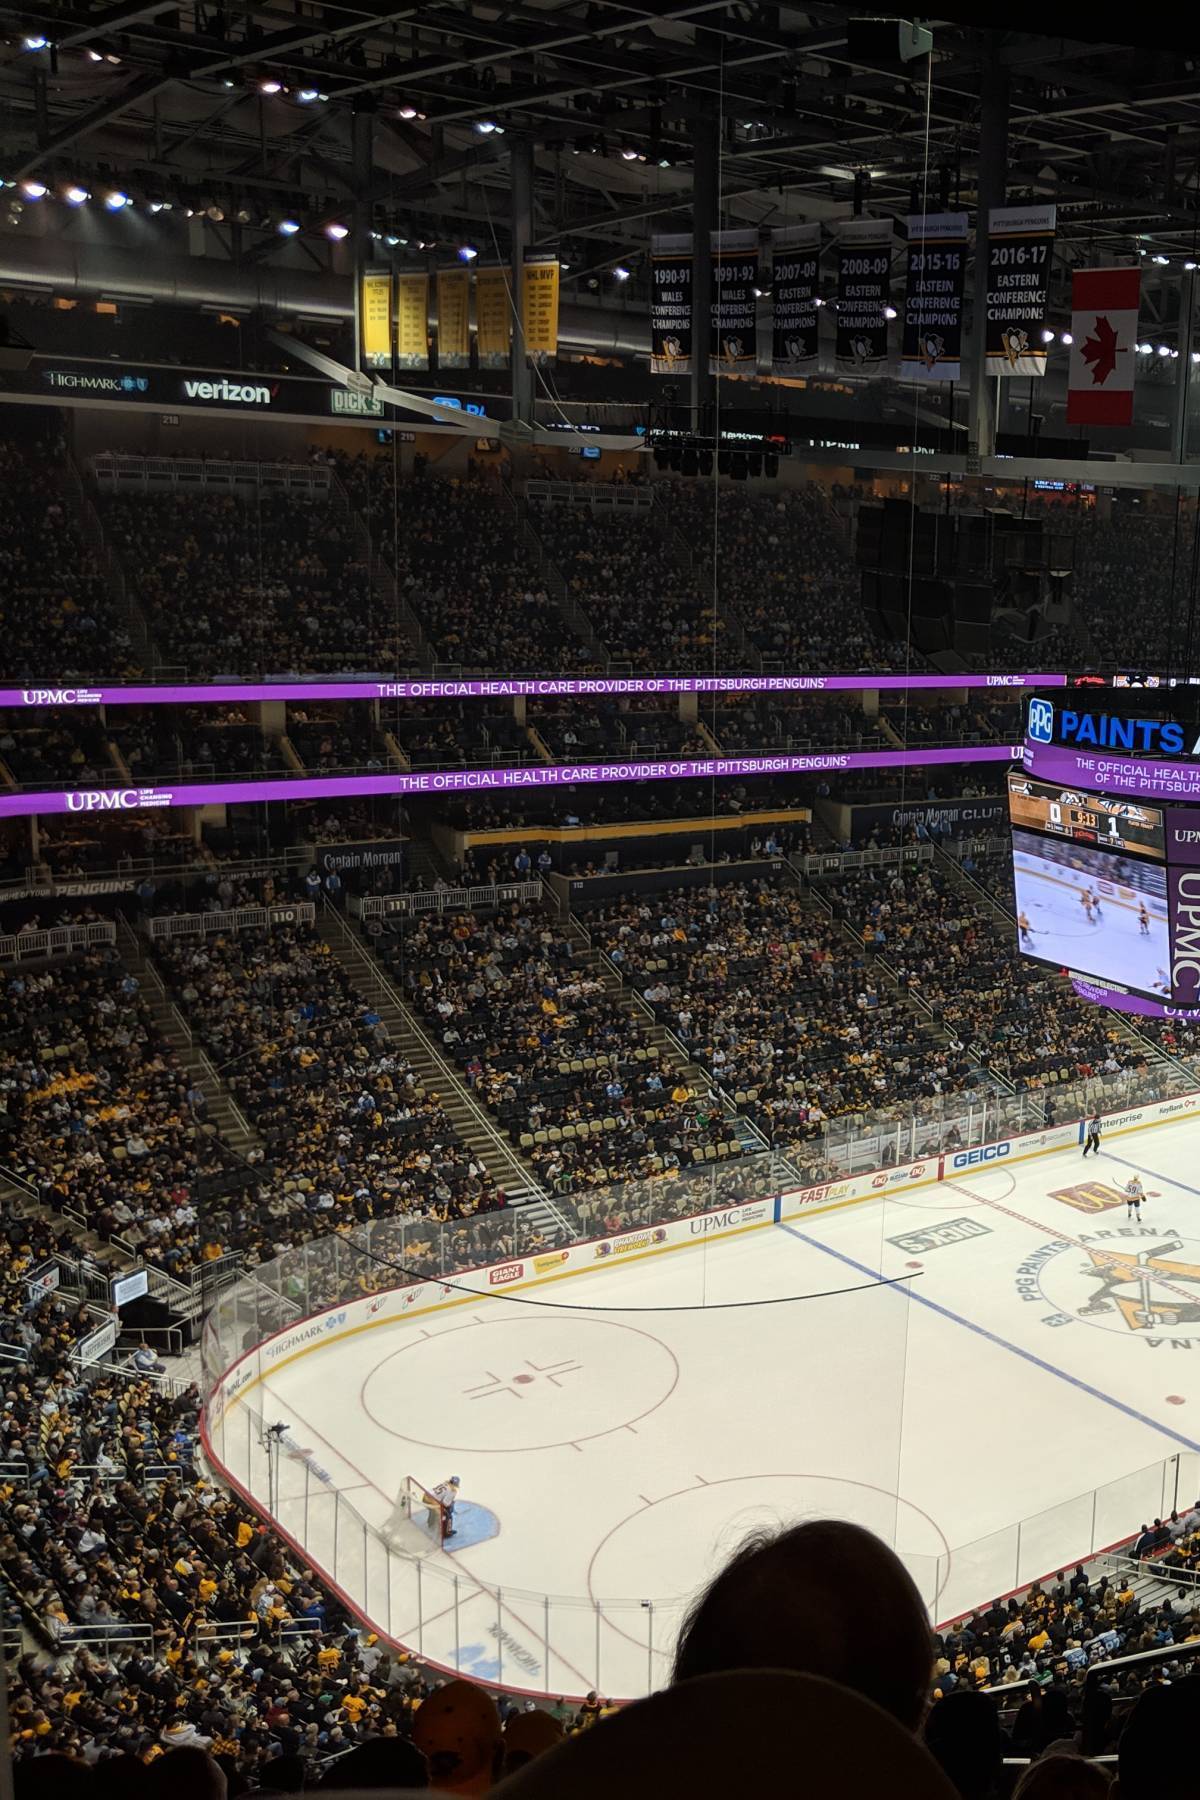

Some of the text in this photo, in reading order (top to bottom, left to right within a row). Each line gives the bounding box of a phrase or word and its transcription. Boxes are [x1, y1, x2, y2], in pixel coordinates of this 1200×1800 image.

[993, 217, 1049, 228] PITTSBURGH PENGUINS
[911, 254, 960, 270] 2015-16
[991, 246, 1047, 265] 2016-17
[714, 266, 754, 282] 1991-92
[775, 261, 816, 281] 2007-08
[841, 258, 888, 274] 2008-09
[654, 268, 690, 284] 1990-91
[997, 274, 1039, 287] EASTERN
[779, 286, 812, 299] EASTERN
[845, 285, 881, 297] EASTERN
[916, 280, 954, 292] EASTERN
[662, 291, 683, 302] WALES
[722, 290, 745, 300] WALES
[987, 291, 1046, 304] CONFERENCE
[652, 305, 691, 315] CONFERENCE
[988, 308, 1043, 320] CHAMPIONS
[653, 319, 690, 329] CHAMPIONS
[712, 318, 753, 329] CHAMPIONS
[51, 372, 119, 390] HIGHMARK
[184, 380, 271, 403] verizon
[377, 684, 406, 697] THE
[410, 683, 476, 696] OFFICIAL
[481, 682, 535, 695] HEALTH
[538, 681, 575, 693] CARE
[578, 680, 644, 693] PROVIDER
[647, 679, 664, 692] OF
[668, 679, 691, 691] THE
[695, 678, 767, 690] PITTSBURGH
[986, 676, 1012, 686] UPMC
[23, 690, 76, 704] UPMC
[1031, 704, 1051, 736] PPG
[1061, 710, 1185, 753] PAINTS
[400, 777, 429, 790] THE
[433, 773, 499, 789] OFFICIAL
[503, 770, 558, 784] HEALTH
[561, 768, 598, 780] CARE
[601, 764, 667, 779] PROVIDER
[670, 763, 688, 775] OF
[690, 761, 714, 774] THE
[717, 758, 789, 772] PITTSBURGH
[1076, 757, 1096, 770] THE
[1097, 761, 1151, 778] OFFICIAL
[1095, 772, 1111, 784] OF
[1113, 774, 1136, 788] THE
[67, 790, 138, 811] UPMC
[1050, 803, 1062, 823] 0
[1077, 812, 1096, 826] 9:13
[1108, 817, 1120, 838] 1
[324, 850, 401, 871] Captain Morgan
[825, 858, 839, 867] 113
[55, 880, 137, 897] PENGUINS
[502, 889, 518, 899] 111
[389, 901, 406, 910] 111
[272, 911, 294, 922] 110
[1159, 1102, 1184, 1115] KeyBank
[1100, 1112, 1143, 1129] nterprise
[953, 1143, 1010, 1168] GEICO
[874, 1176, 886, 1186] DQ
[912, 1167, 924, 1176] DQ
[690, 1211, 740, 1235] UPMC
[898, 1219, 982, 1254] DICK'S
[492, 1265, 520, 1276] GIANT
[1015, 1227, 1181, 1302] PPG PAINTS ARENA
[492, 1272, 520, 1283] EAGLE
[266, 1323, 323, 1357] HIGHMARK
